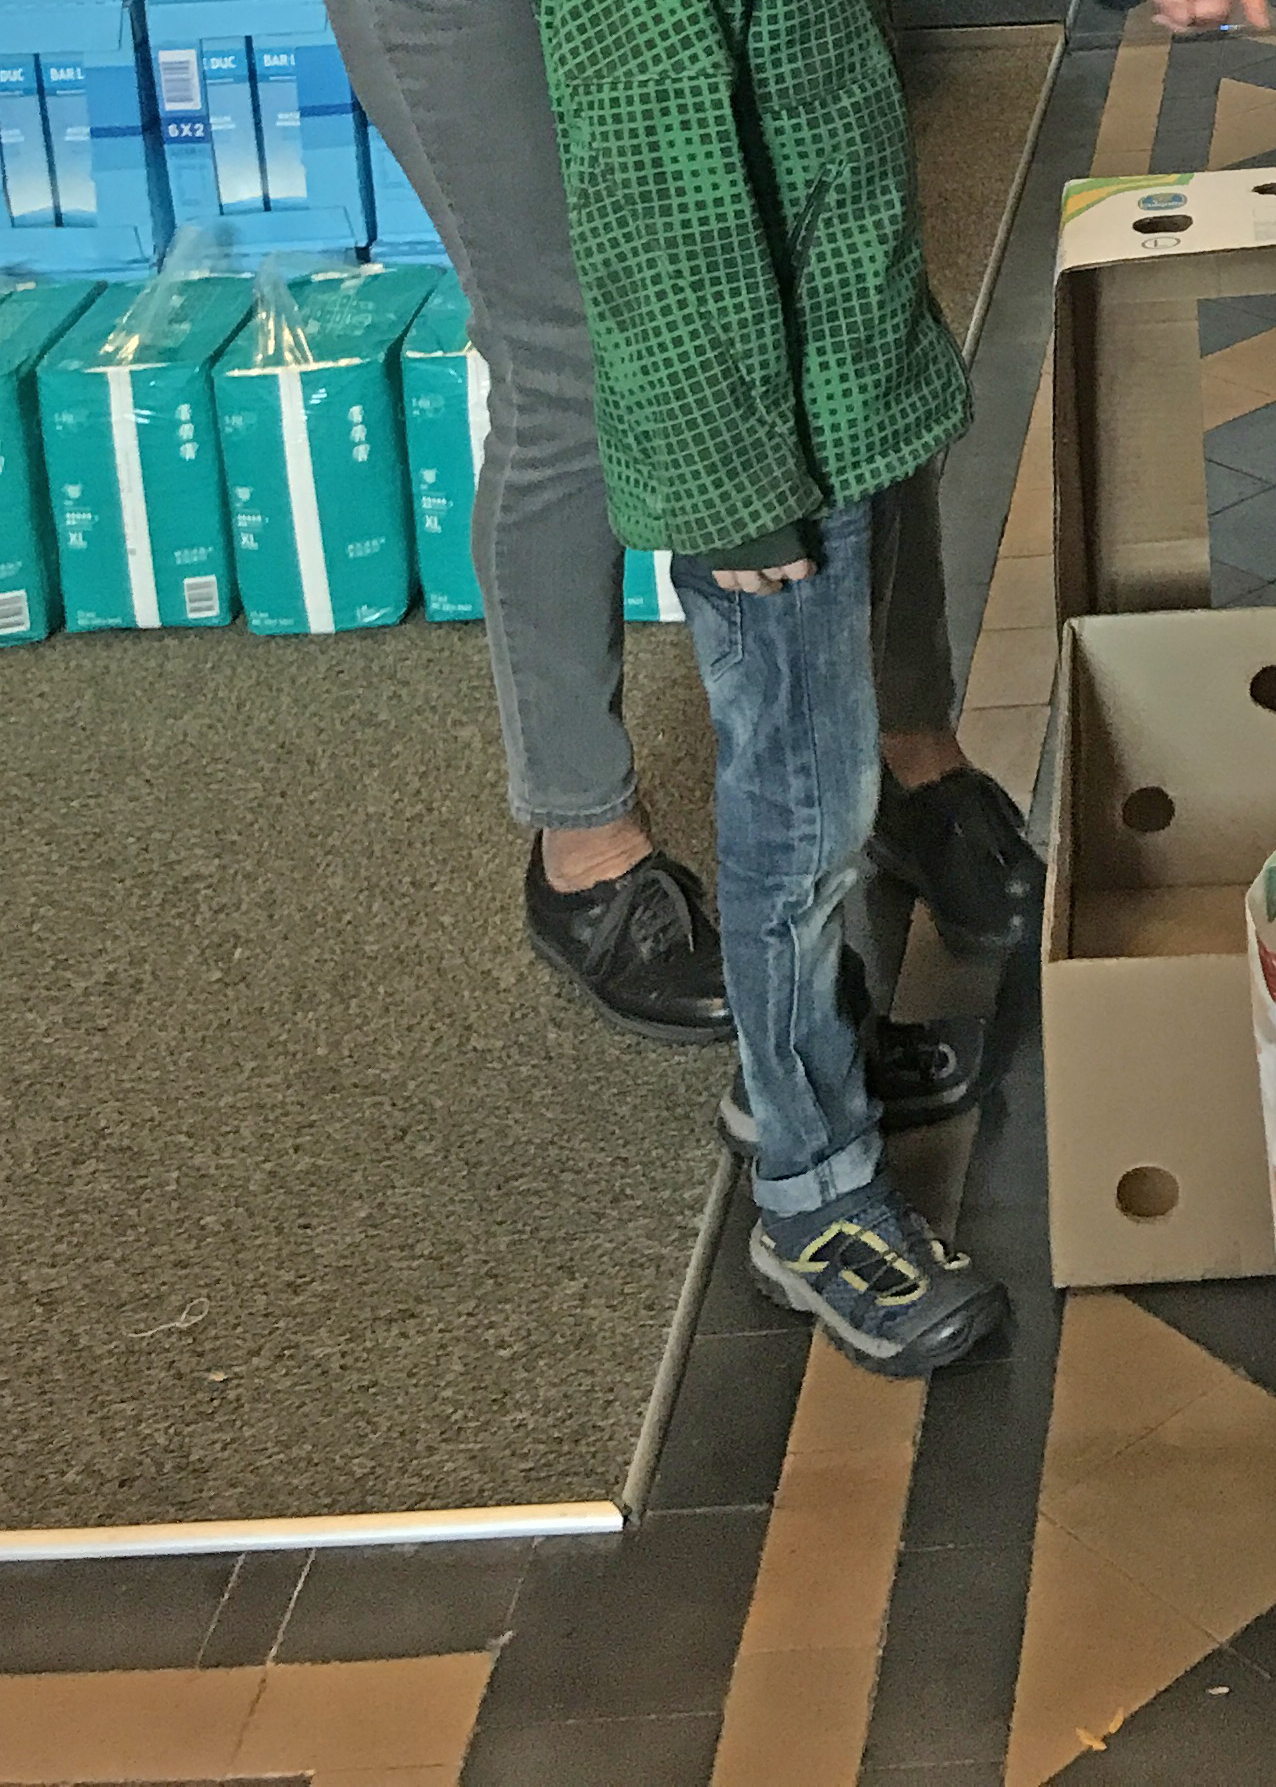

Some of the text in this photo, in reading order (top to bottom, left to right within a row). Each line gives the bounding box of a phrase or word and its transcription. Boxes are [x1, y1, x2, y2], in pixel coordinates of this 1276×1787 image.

[210, 56, 237, 69] DUC
[263, 53, 288, 67] BAR
[50, 67, 74, 81] BAR
